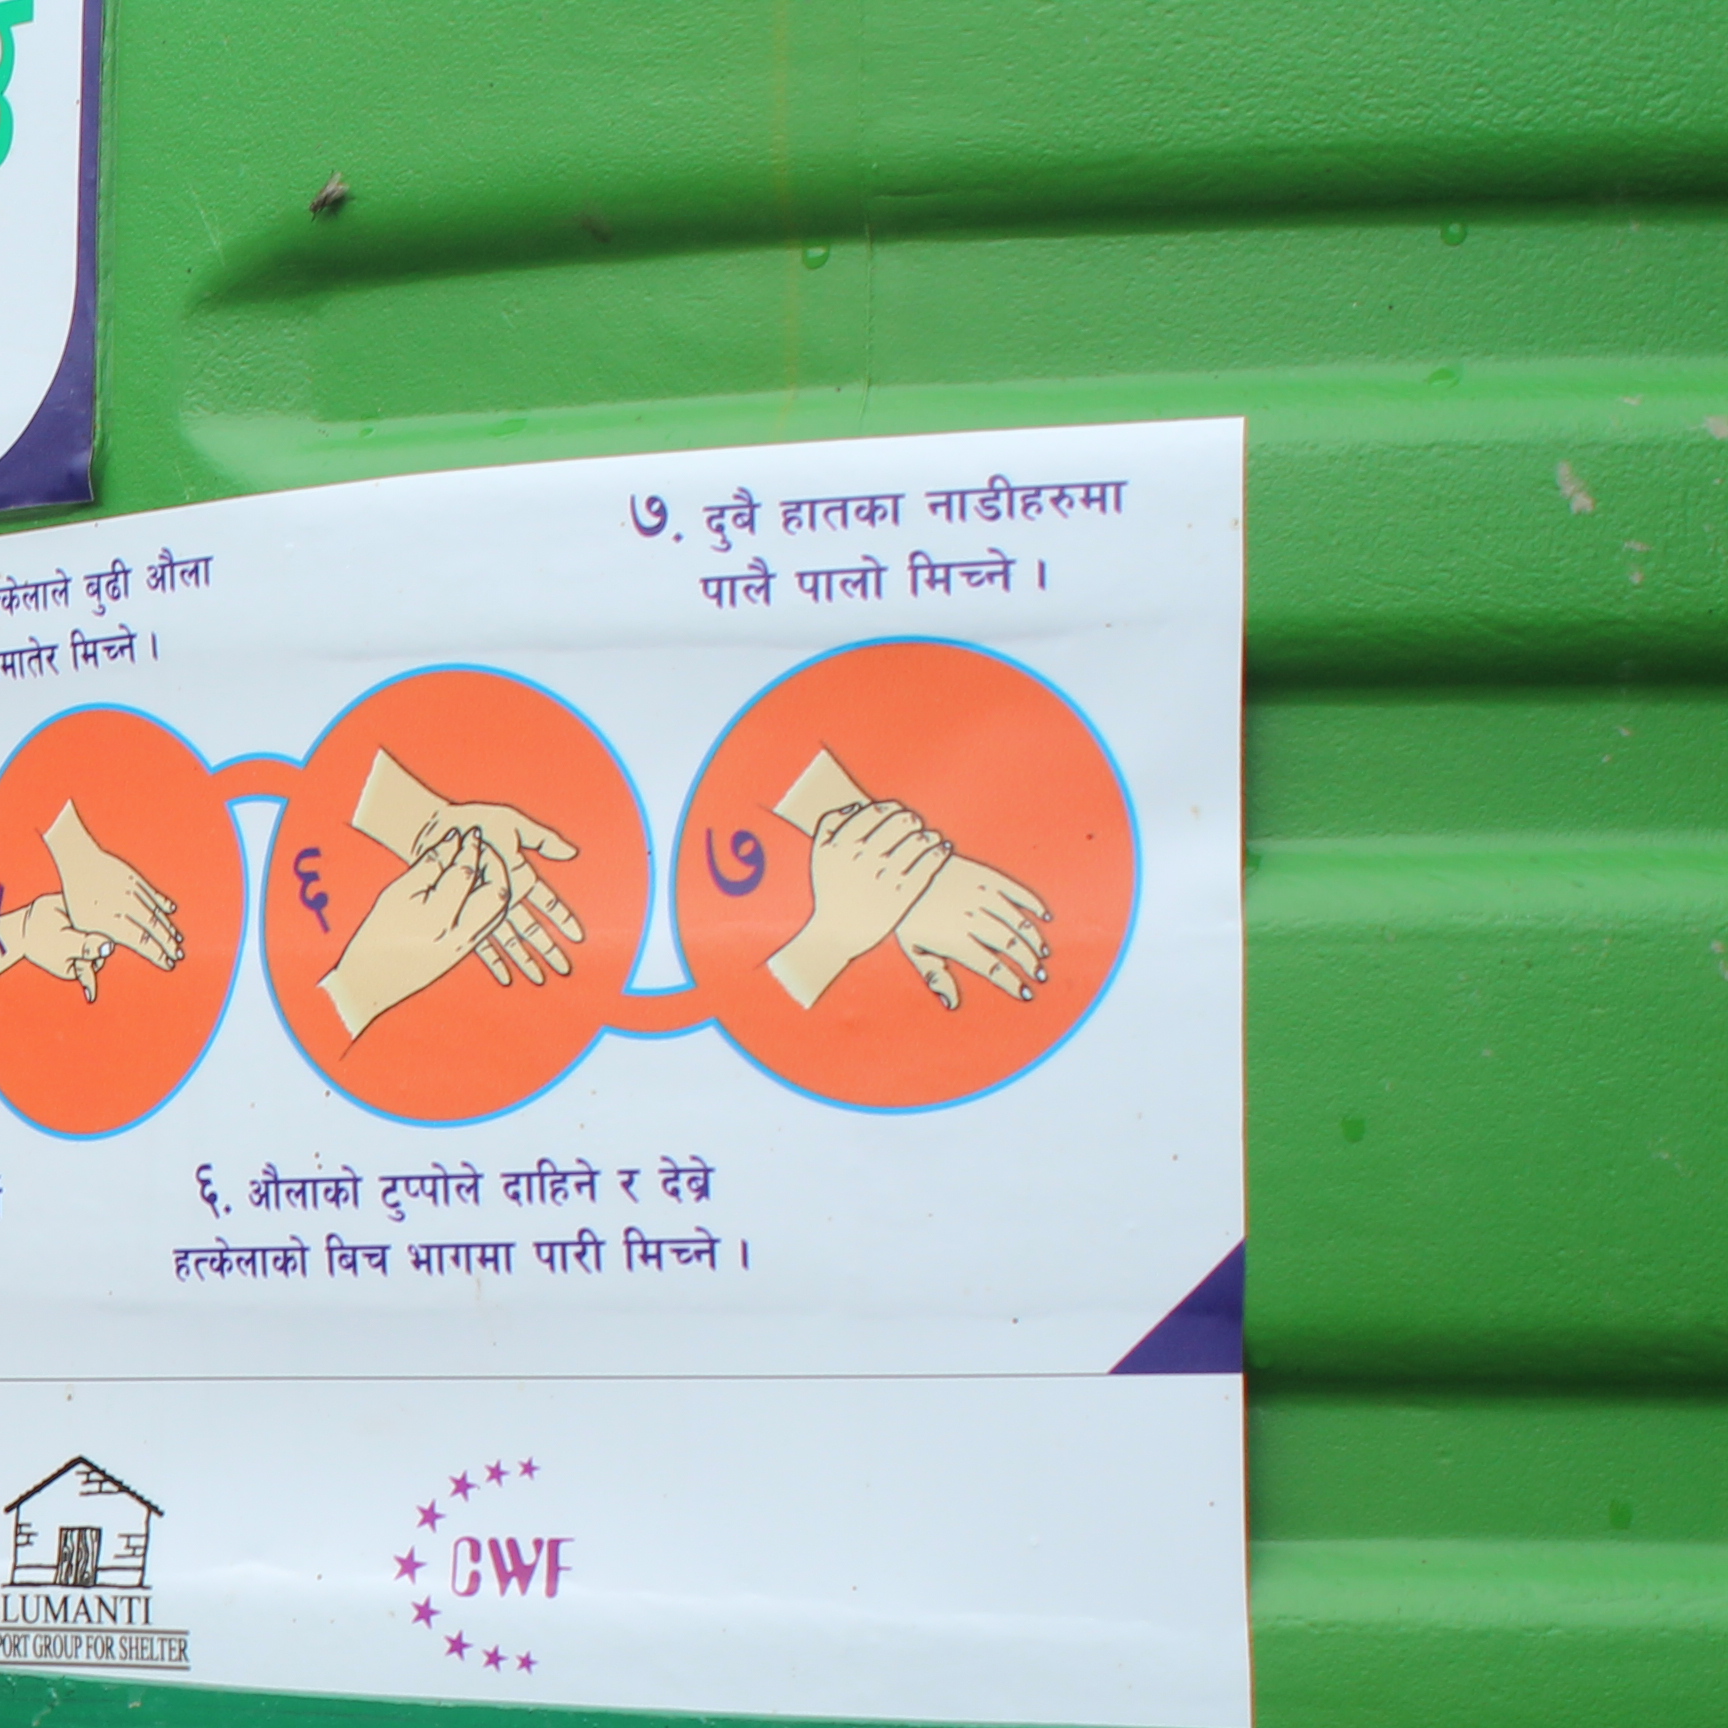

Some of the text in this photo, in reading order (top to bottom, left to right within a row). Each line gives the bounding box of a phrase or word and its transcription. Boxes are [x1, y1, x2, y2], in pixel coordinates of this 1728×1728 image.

[702, 487, 761, 552] दुबै
[780, 492, 905, 534] हातका
[926, 474, 1128, 523] नाडीहरुमा
[83, 558, 133, 616] बुढी
[700, 557, 776, 609] पालै
[796, 554, 888, 602] पालो
[908, 550, 1016, 597] मिच्ने
[70, 624, 138, 671] मिच्ने
[293, 847, 330, 934] ६
[705, 827, 766, 897] ७
[379, 1162, 484, 1222] टुप्पोले
[501, 1159, 600, 1205] दाहिने
[619, 1169, 640, 1203] र
[659, 1156, 715, 1203] देब्रे
[174, 1235, 309, 1281] हत्केलाको
[326, 1234, 391, 1276] बिच
[407, 1241, 515, 1274] भागमा
[533, 1228, 605, 1274] पारी
[624, 1228, 721, 1272] मिच्ने
[451, 1536, 575, 1599] CWF
[1, 1594, 152, 1625] LUMANTI
[32, 1633, 83, 1661] GROUP
[86, 1633, 116, 1662] FOR
[118, 1634, 189, 1663] SHELTER
